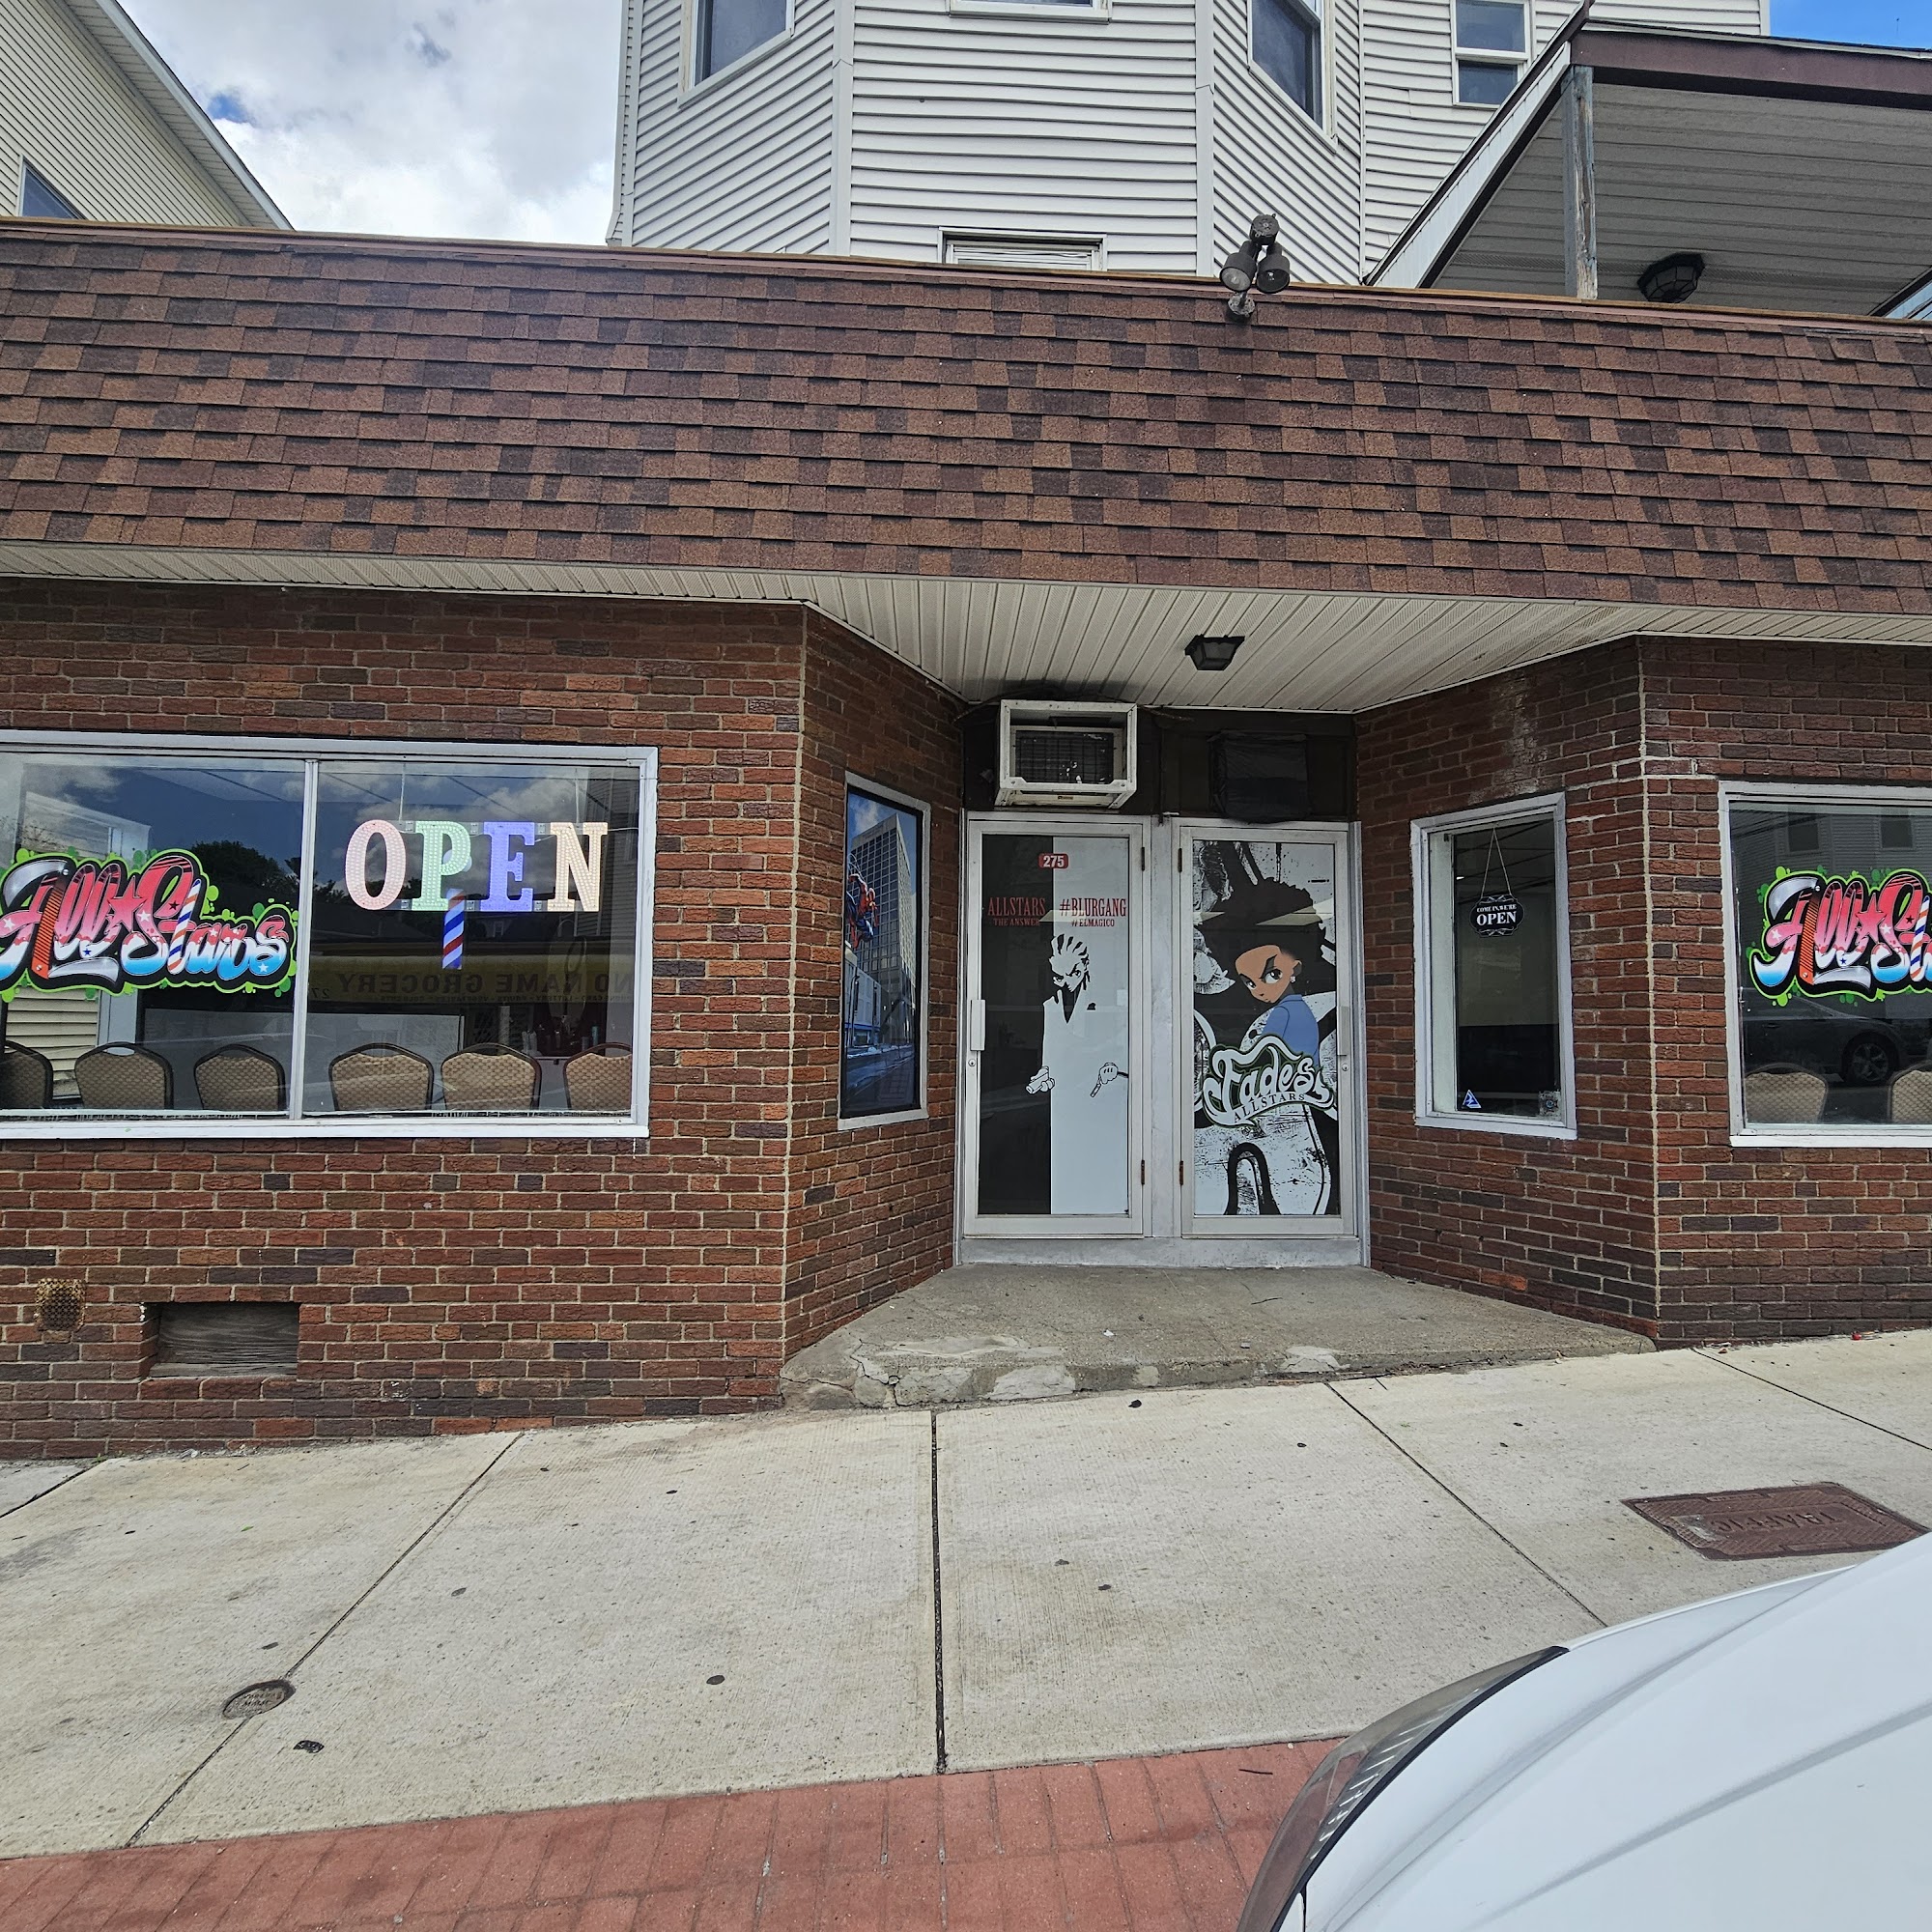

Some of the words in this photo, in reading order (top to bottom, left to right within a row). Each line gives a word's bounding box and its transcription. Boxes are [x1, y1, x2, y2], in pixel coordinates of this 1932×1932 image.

[345, 819, 608, 912] OPEN
[1043, 855, 1065, 867] 275
[987, 897, 1046, 917] ALLSTARS
[1060, 897, 1126, 917] #BLURGANG
[993, 918, 1009, 926] THE
[1009, 918, 1040, 926] ANSWER
[1071, 919, 1115, 927] #ELMAGICO
[1476, 911, 1517, 925] OPEN
[1234, 1093, 1305, 1123] ALLSTARS
